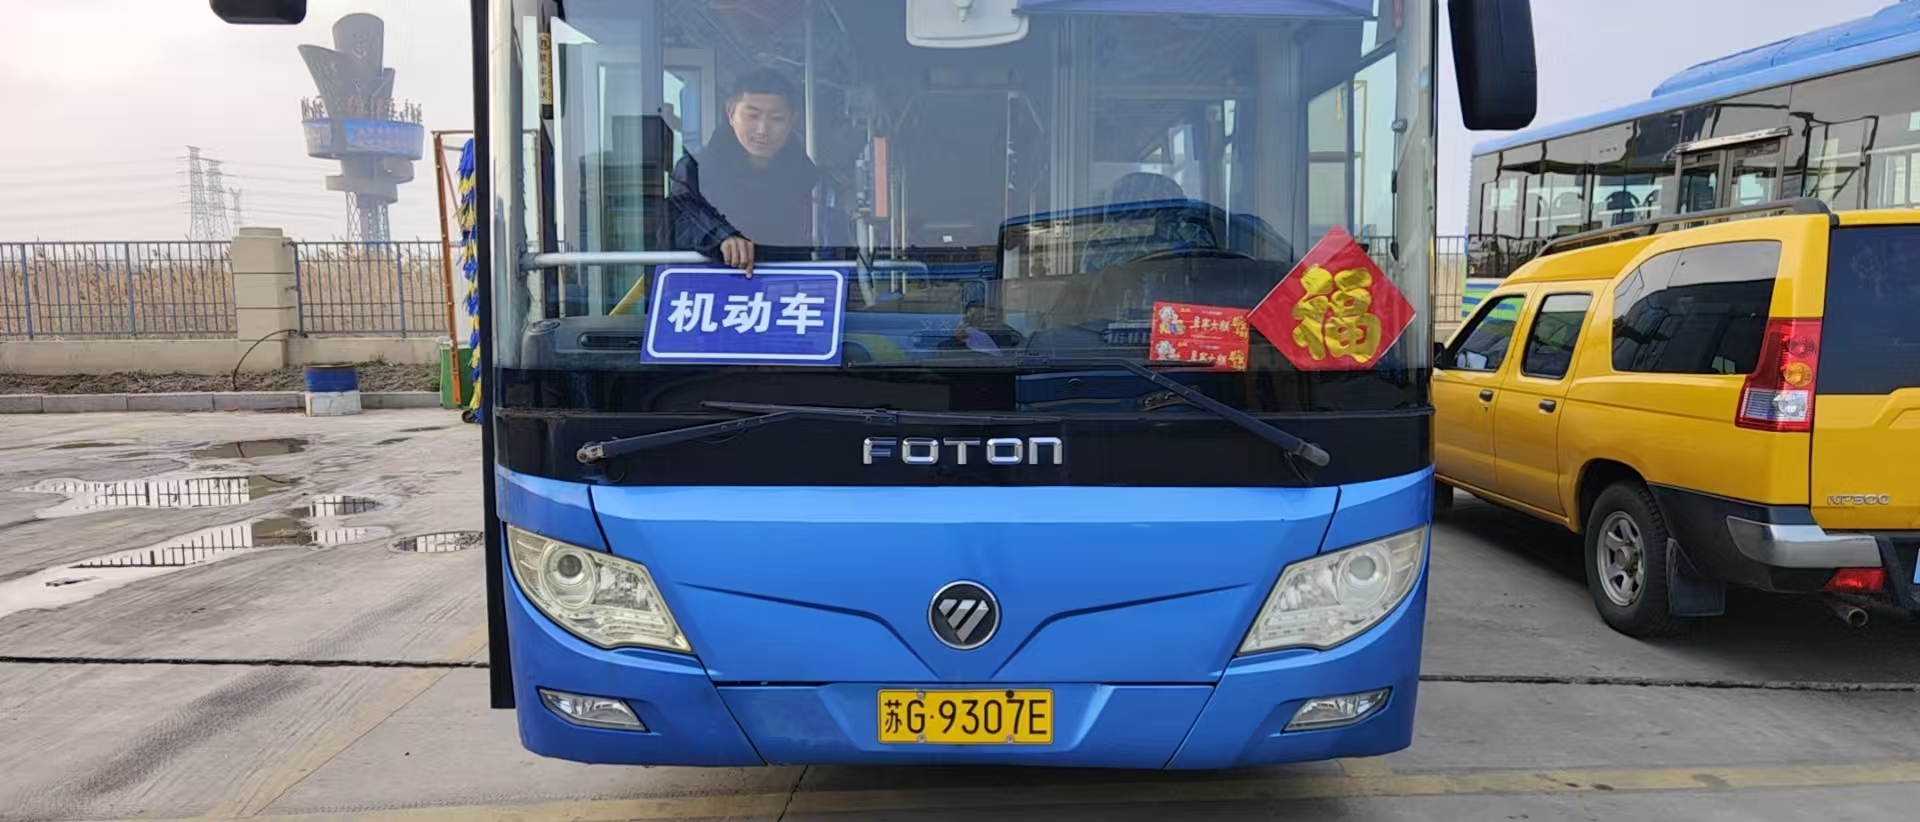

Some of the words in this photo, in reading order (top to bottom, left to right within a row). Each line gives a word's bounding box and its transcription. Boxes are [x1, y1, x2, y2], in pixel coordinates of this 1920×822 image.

[667, 291, 825, 334] 机动车
[1292, 264, 1381, 363] 福
[863, 437, 1062, 464] FOTON
